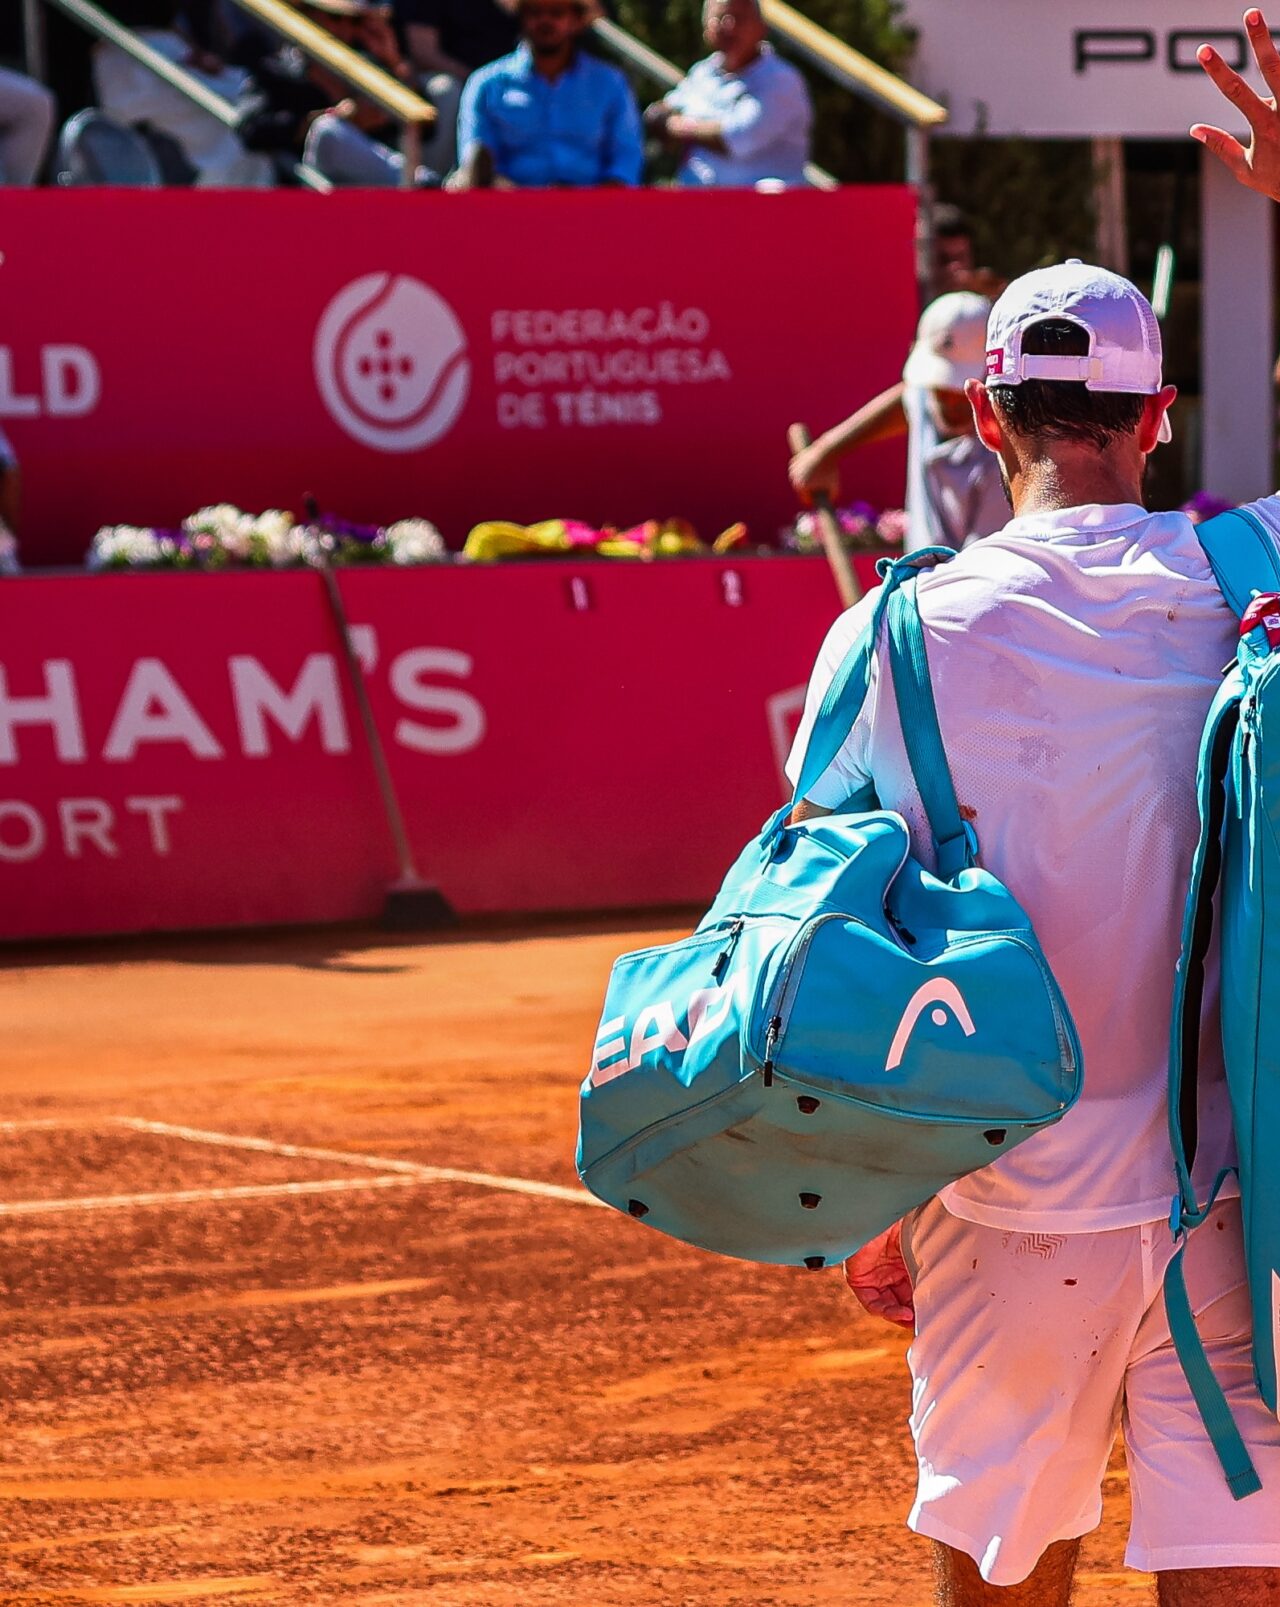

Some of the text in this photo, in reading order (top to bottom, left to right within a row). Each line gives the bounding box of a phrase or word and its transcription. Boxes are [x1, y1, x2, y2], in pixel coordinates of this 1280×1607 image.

[490, 299, 710, 345] FEDERAÇÃO
[493, 348, 732, 386] PORTUGUESA
[497, 383, 662, 430] DE TÉNIS
